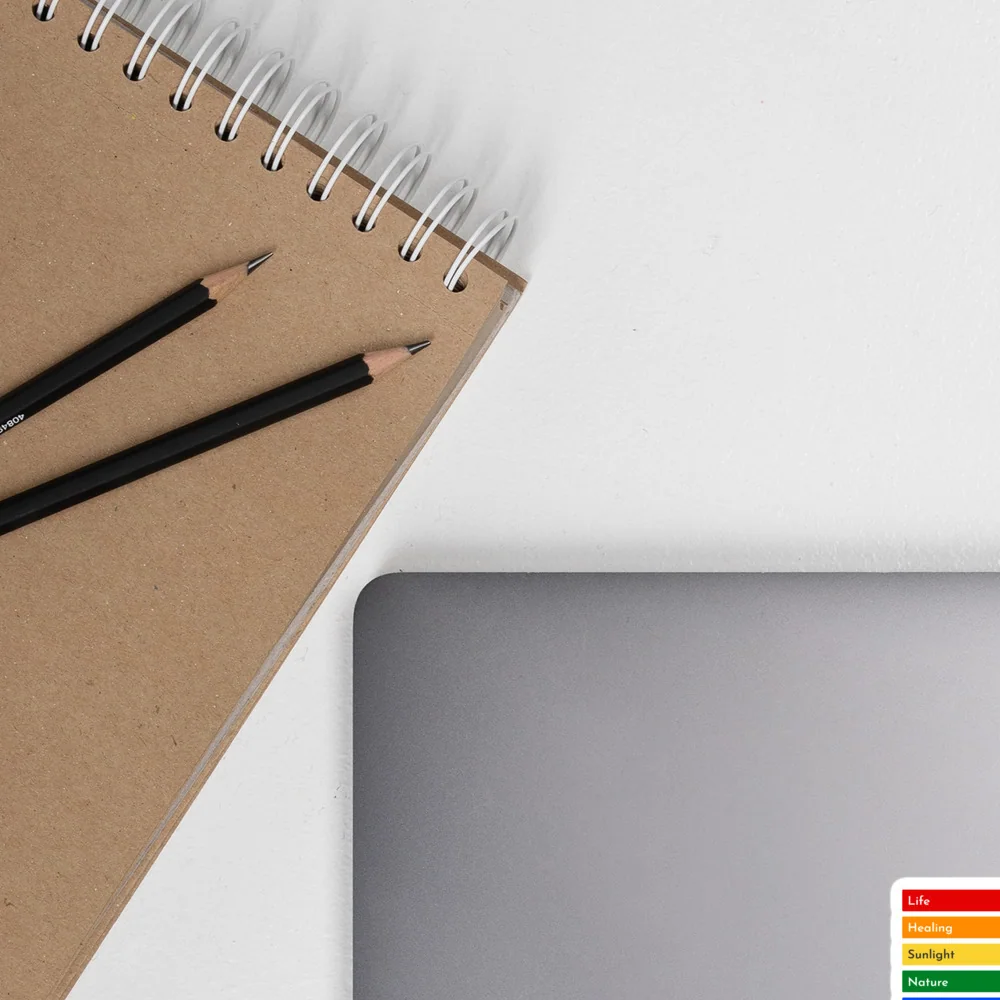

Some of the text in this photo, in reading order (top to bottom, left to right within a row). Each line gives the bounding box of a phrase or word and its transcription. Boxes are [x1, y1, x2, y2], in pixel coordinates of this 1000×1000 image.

[908, 895, 930, 906] Life
[908, 922, 953, 934] Healing
[908, 949, 955, 961] Sunlight
[908, 977, 949, 988] Nature
